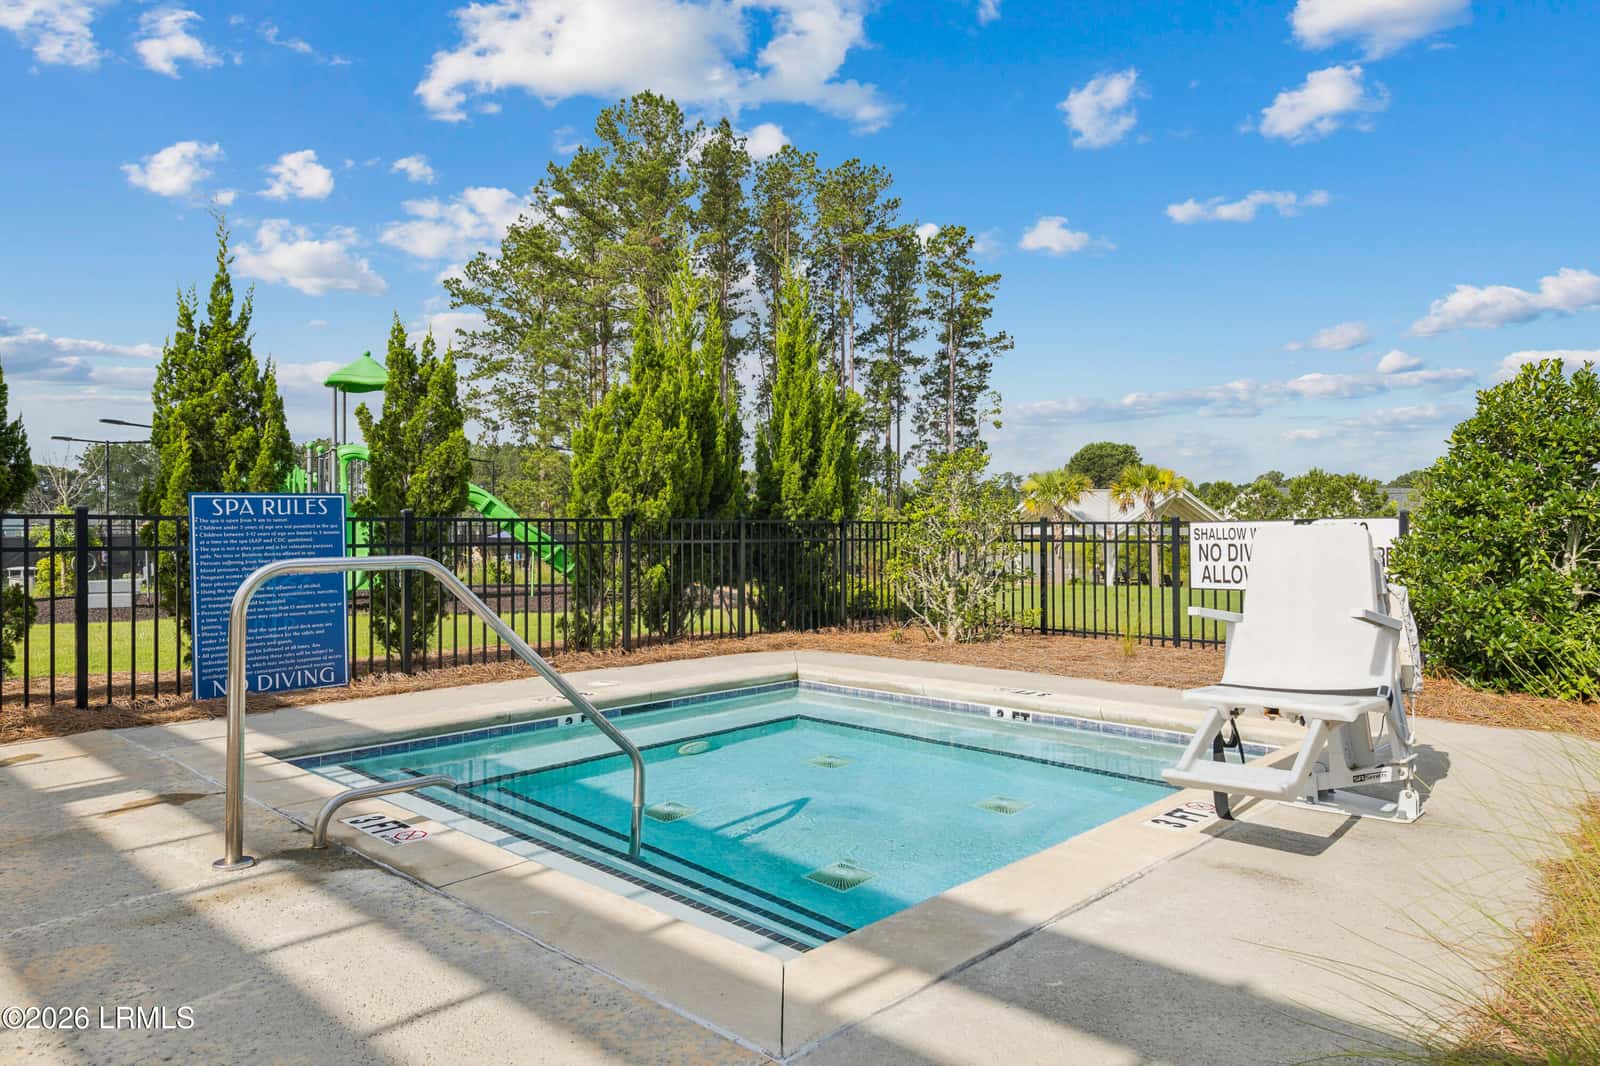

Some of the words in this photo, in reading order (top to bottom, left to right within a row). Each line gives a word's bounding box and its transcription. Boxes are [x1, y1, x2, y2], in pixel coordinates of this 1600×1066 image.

[212, 499, 254, 516] SPA
[262, 499, 328, 515] RULES
[1194, 527, 1246, 540] SHALLOW
[1199, 544, 1222, 562] NO
[1228, 544, 1254, 562] DIV
[258, 667, 334, 691] DIVING
[1152, 818, 1187, 828] 3
[1164, 808, 1209, 823] FT
[362, 820, 410, 834] FT
